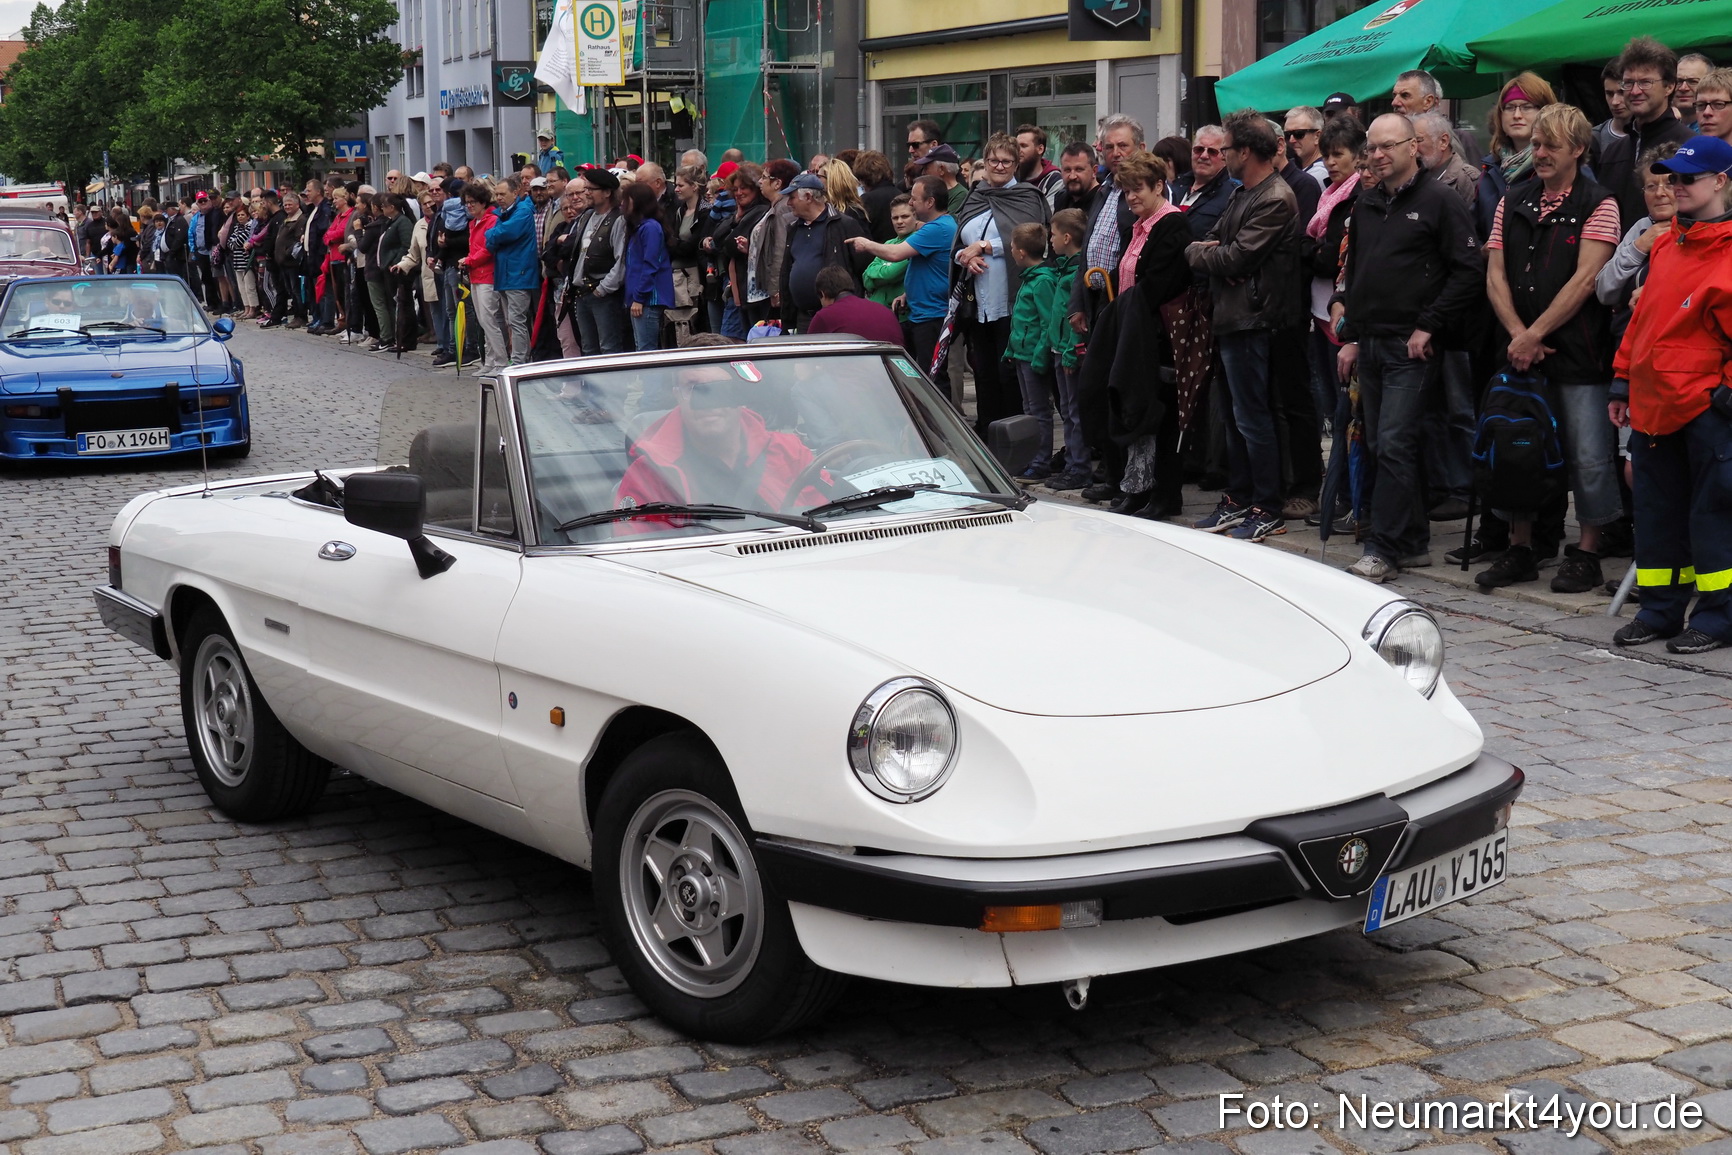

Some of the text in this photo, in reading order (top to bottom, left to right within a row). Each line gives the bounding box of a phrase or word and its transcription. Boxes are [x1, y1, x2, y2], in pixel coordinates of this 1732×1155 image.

[1318, 31, 1393, 50] Neumarkter
[1283, 41, 1386, 67] Lammsbräu
[508, 73, 524, 92] G2
[86, 431, 168, 450] FO X 196H
[908, 467, 946, 484] 534
[1383, 865, 1436, 921] LAU
[1371, 909, 1378, 921] D
